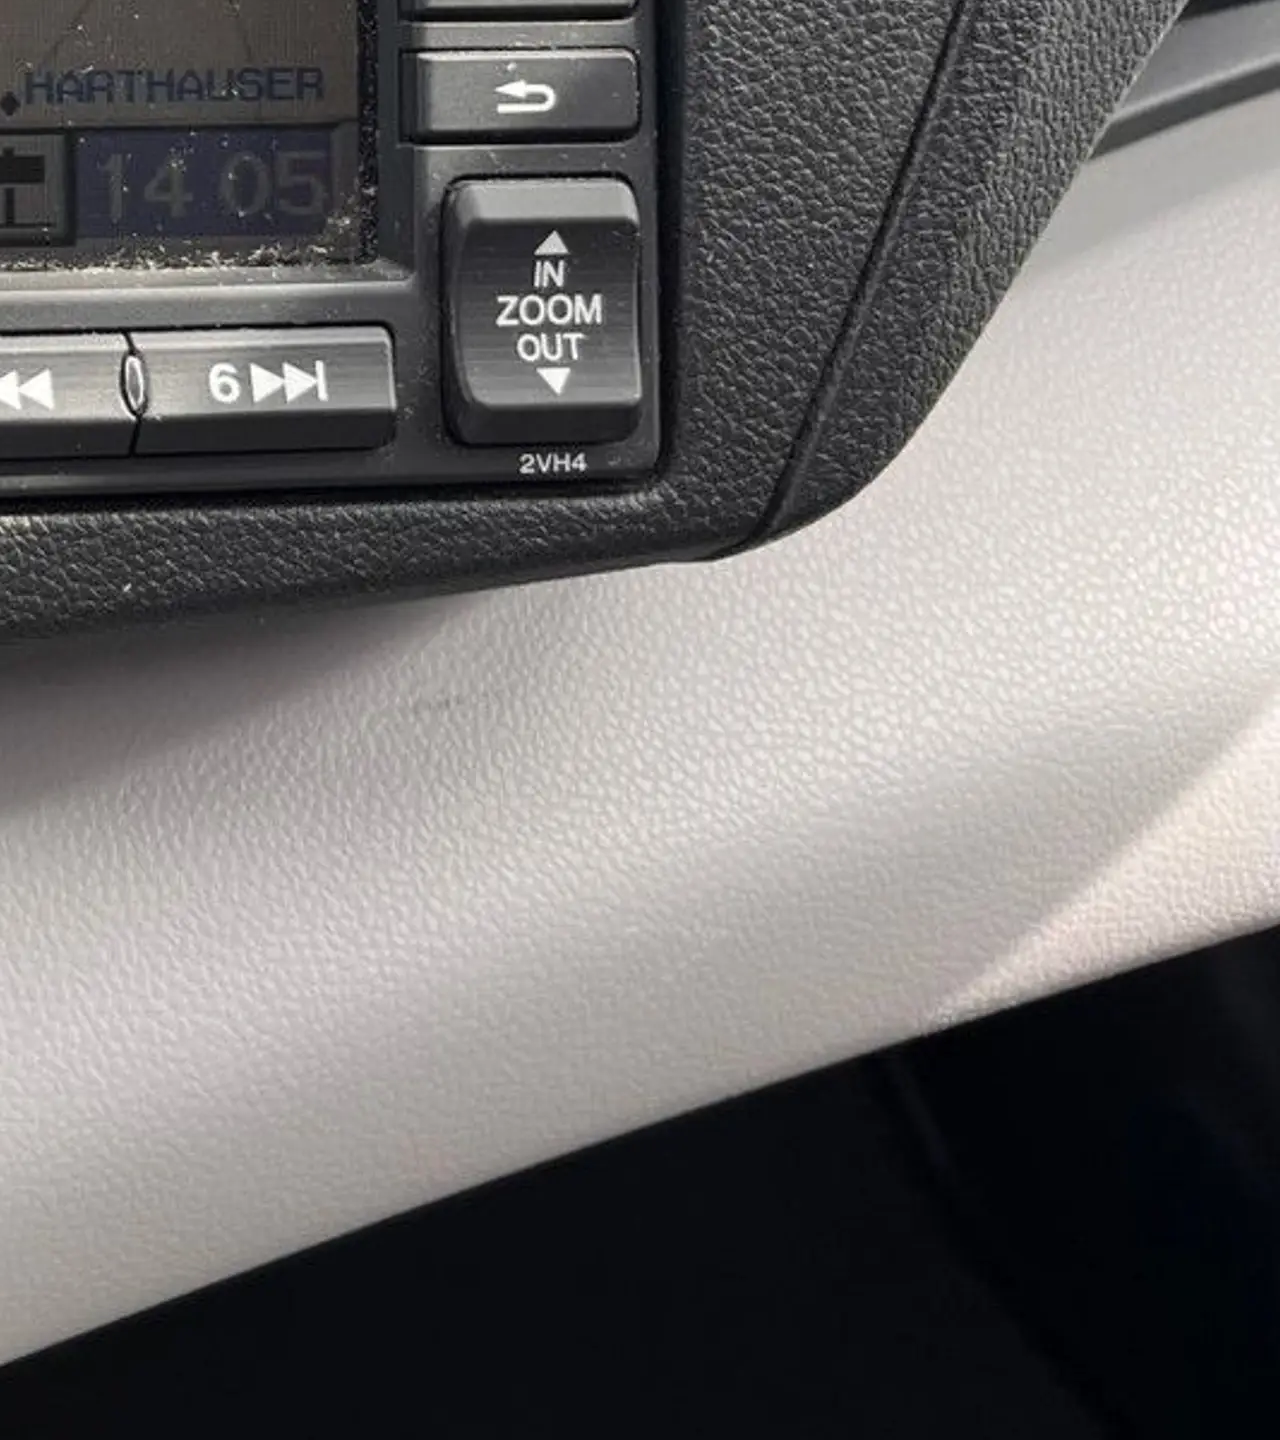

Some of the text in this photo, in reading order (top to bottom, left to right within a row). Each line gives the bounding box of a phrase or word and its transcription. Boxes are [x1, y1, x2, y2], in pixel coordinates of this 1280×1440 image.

[534, 259, 565, 287] IN
[496, 295, 603, 328] ZOOM
[517, 331, 585, 362] OUT
[208, 364, 240, 405] 6
[520, 451, 587, 475] 2VH4
